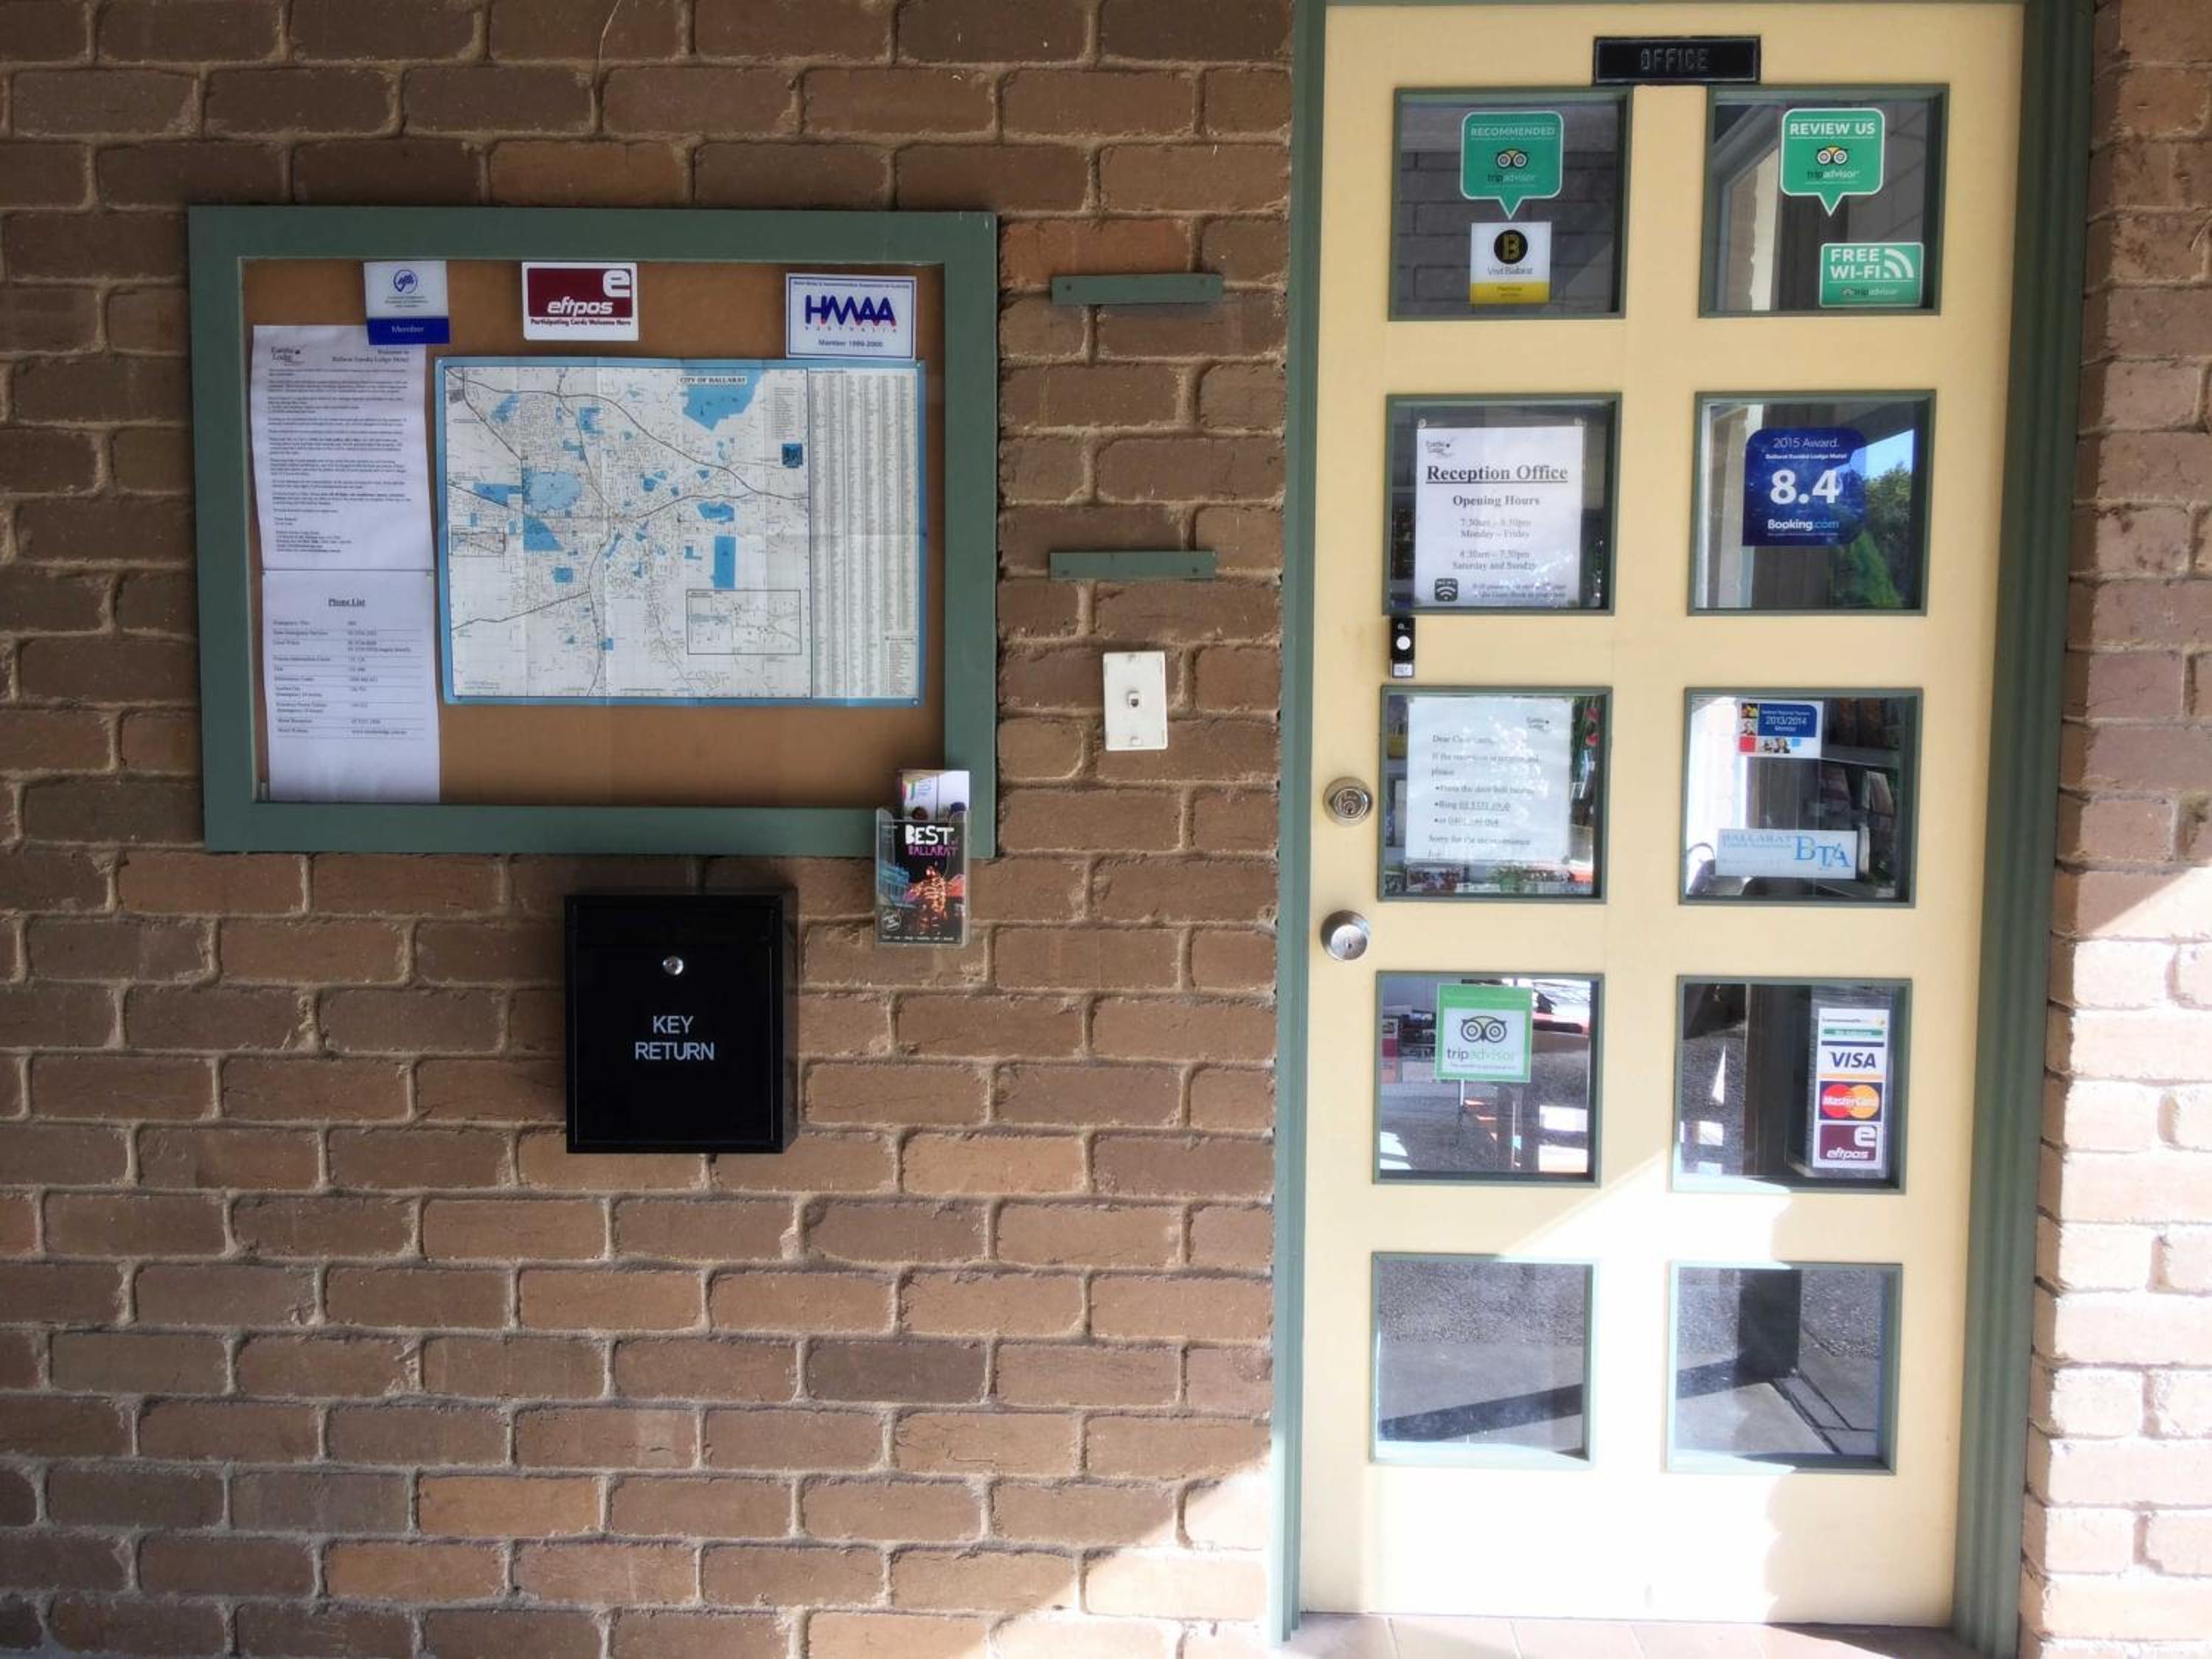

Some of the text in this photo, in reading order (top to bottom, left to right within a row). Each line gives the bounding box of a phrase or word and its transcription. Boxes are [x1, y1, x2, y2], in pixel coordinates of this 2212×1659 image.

[1641, 48, 1709, 72] OFFICE
[1471, 127, 1556, 137] RECOMMENDED
[1790, 122, 1876, 135] REVIEW US
[1807, 170, 1857, 180] tripadvisor
[1502, 233, 1521, 260] B
[1831, 248, 1879, 262] FREE
[1829, 265, 1879, 279] WI-FI
[547, 296, 613, 317] eftpos
[391, 325, 425, 333] Member
[531, 319, 568, 327] Participating
[1773, 437, 1837, 448] 2015 Award
[1427, 465, 1568, 482] Reception Office
[1770, 469, 1840, 504] 8.4
[1453, 495, 1540, 508] Opening Hours
[1767, 519, 1839, 531] Booking.com
[1461, 530, 1494, 540] Monday
[352, 598, 366, 607] List
[1765, 716, 1806, 726] 2013/2014
[1433, 735, 1452, 743] Dear
[905, 824, 954, 845] BEST
[908, 845, 958, 856] BALLARAT
[1793, 835, 1852, 868] BTA
[653, 1015, 694, 1034] KEY
[635, 1041, 714, 1060] RETURN
[1829, 1052, 1877, 1068] VISA
[1826, 1147, 1869, 1160] eftpos
